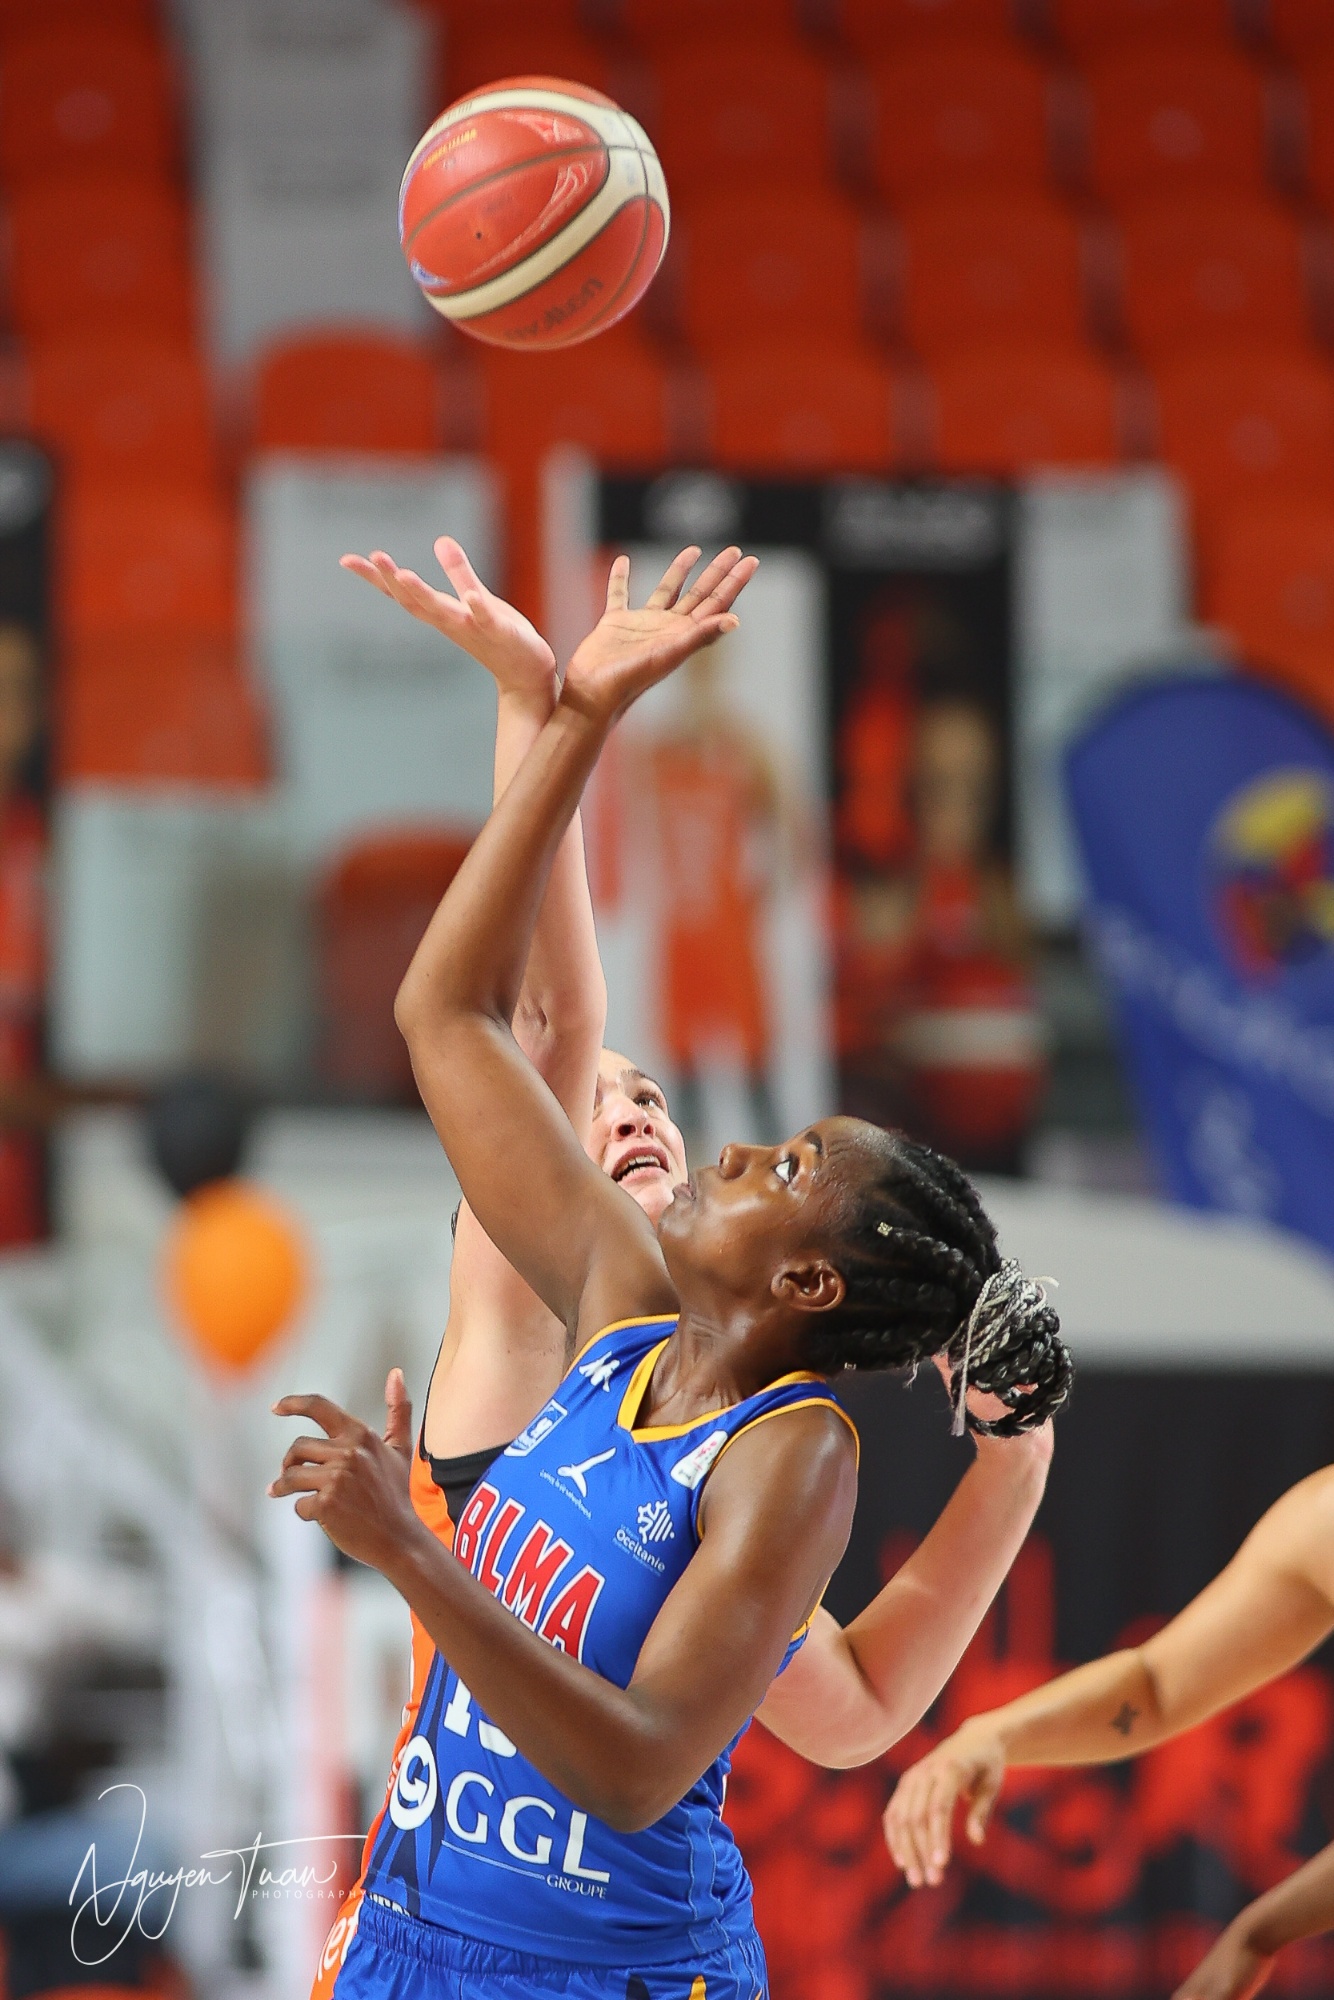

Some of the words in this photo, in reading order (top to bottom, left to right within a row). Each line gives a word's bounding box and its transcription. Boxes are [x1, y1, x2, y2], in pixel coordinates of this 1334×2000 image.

[455, 1482, 607, 1663] BLMA
[616, 1529, 665, 1572] Occitanie
[445, 1771, 611, 1882] GGL
[547, 1874, 608, 1900] GROUPE
